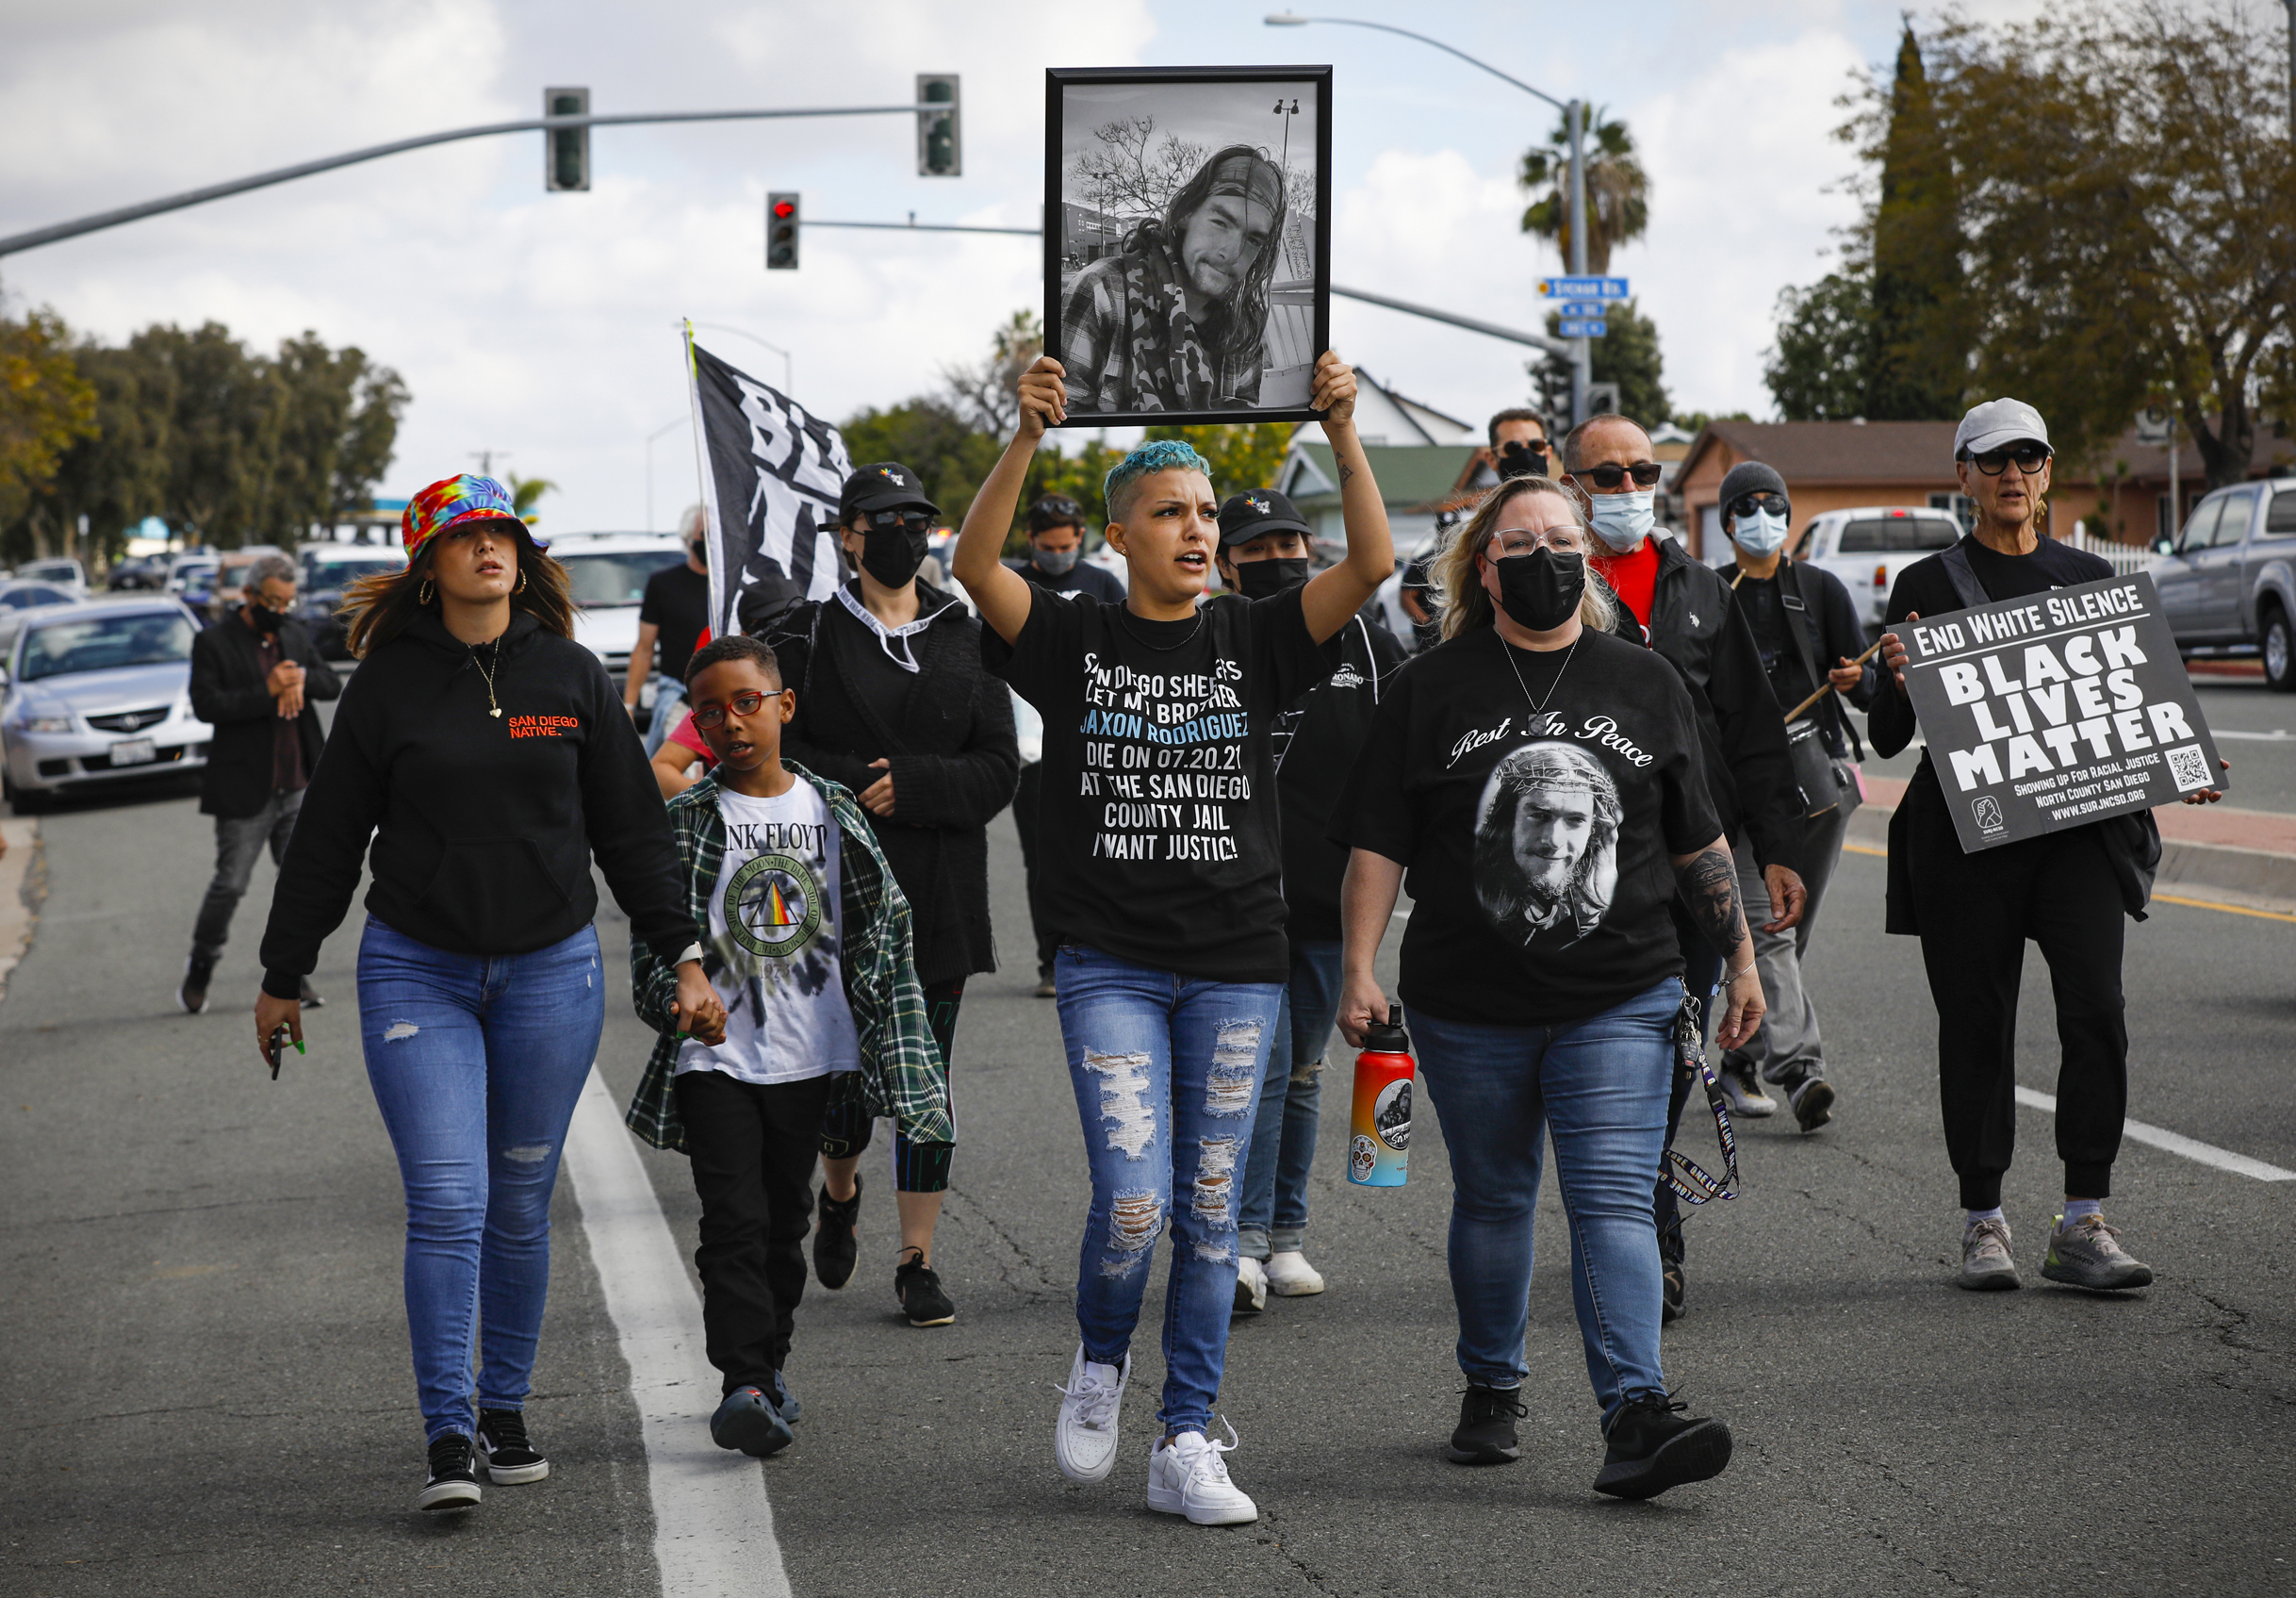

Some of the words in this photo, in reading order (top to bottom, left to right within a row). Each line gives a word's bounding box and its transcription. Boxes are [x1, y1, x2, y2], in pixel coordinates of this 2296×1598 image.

[1912, 622, 1966, 657] END
[1966, 604, 2045, 645] WHITE
[2046, 585, 2144, 624] SILENCE
[1938, 625, 2148, 706] BLACK
[1086, 679, 1118, 707] LET
[1156, 684, 1242, 725] BROTHER
[1970, 668, 2144, 743] LIVES
[509, 716, 536, 727] SAN
[539, 716, 579, 728] DIEGO
[510, 726, 563, 739] NATIVE.
[1147, 712, 1250, 745] RODRIGUEZ
[1087, 741, 1116, 768] DIE
[1122, 747, 1151, 768] ON
[1156, 744, 1241, 769] 07.20.21
[1446, 717, 1512, 769] Rest
[1574, 715, 1654, 767] Peace
[1948, 701, 2195, 792] MATTER
[1080, 772, 1100, 796] AT
[1106, 774, 1144, 799] THE
[1149, 774, 1192, 799] SAN
[1196, 774, 1251, 800] DIEGO
[2013, 778, 2057, 797] SHOWING
[2056, 773, 2070, 786] UP
[2072, 769, 2091, 783] FOR
[2090, 762, 2124, 778] RACIAL
[2125, 752, 2161, 770] JUSTICE
[2035, 792, 2067, 809] NORTH
[2066, 782, 2103, 801] COUNTY
[2103, 778, 2123, 792] SAN
[2124, 771, 2151, 787] DIEGO
[1104, 802, 1182, 828] COUNTY
[1192, 804, 1230, 831] JAIL
[725, 823, 760, 851] NK
[1100, 833, 1158, 860] WANT
[1165, 834, 1238, 862] JUSTIC!
[731, 872, 747, 892] THE
[745, 857, 771, 876] MOON
[773, 857, 790, 869] THE
[790, 862, 810, 885] DARK
[806, 885, 819, 907] SIDE
[759, 964, 791, 980] 1973
[1721, 1128, 1734, 1152] LOVE
[1669, 1178, 1692, 1198] LOVE
[1690, 1165, 1709, 1186] ONE
